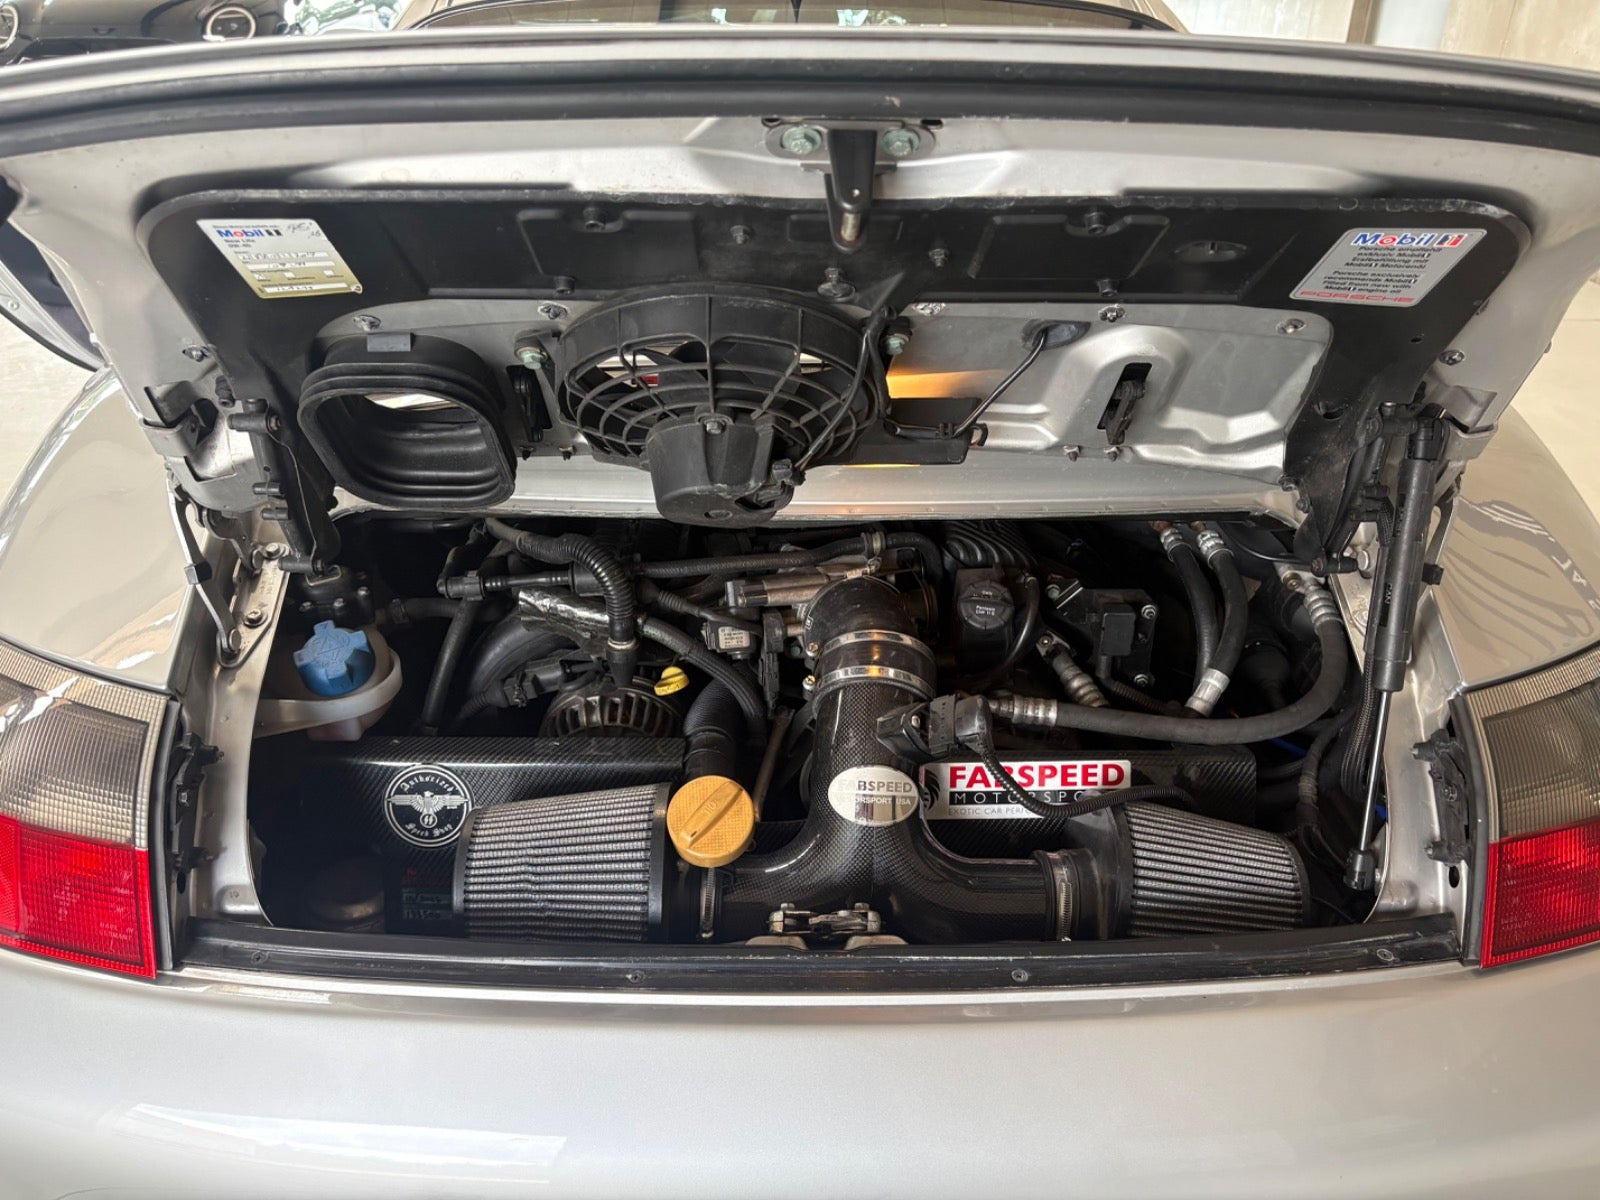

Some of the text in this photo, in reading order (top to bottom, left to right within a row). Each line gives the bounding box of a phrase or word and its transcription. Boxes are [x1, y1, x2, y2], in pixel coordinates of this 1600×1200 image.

[1353, 233, 1437, 245] Mobil
[1300, 291, 1414, 302] PORSCHE
[896, 798, 911, 806] USA
[948, 807, 979, 816] EXOTIC
[984, 806, 1003, 815] CAR
